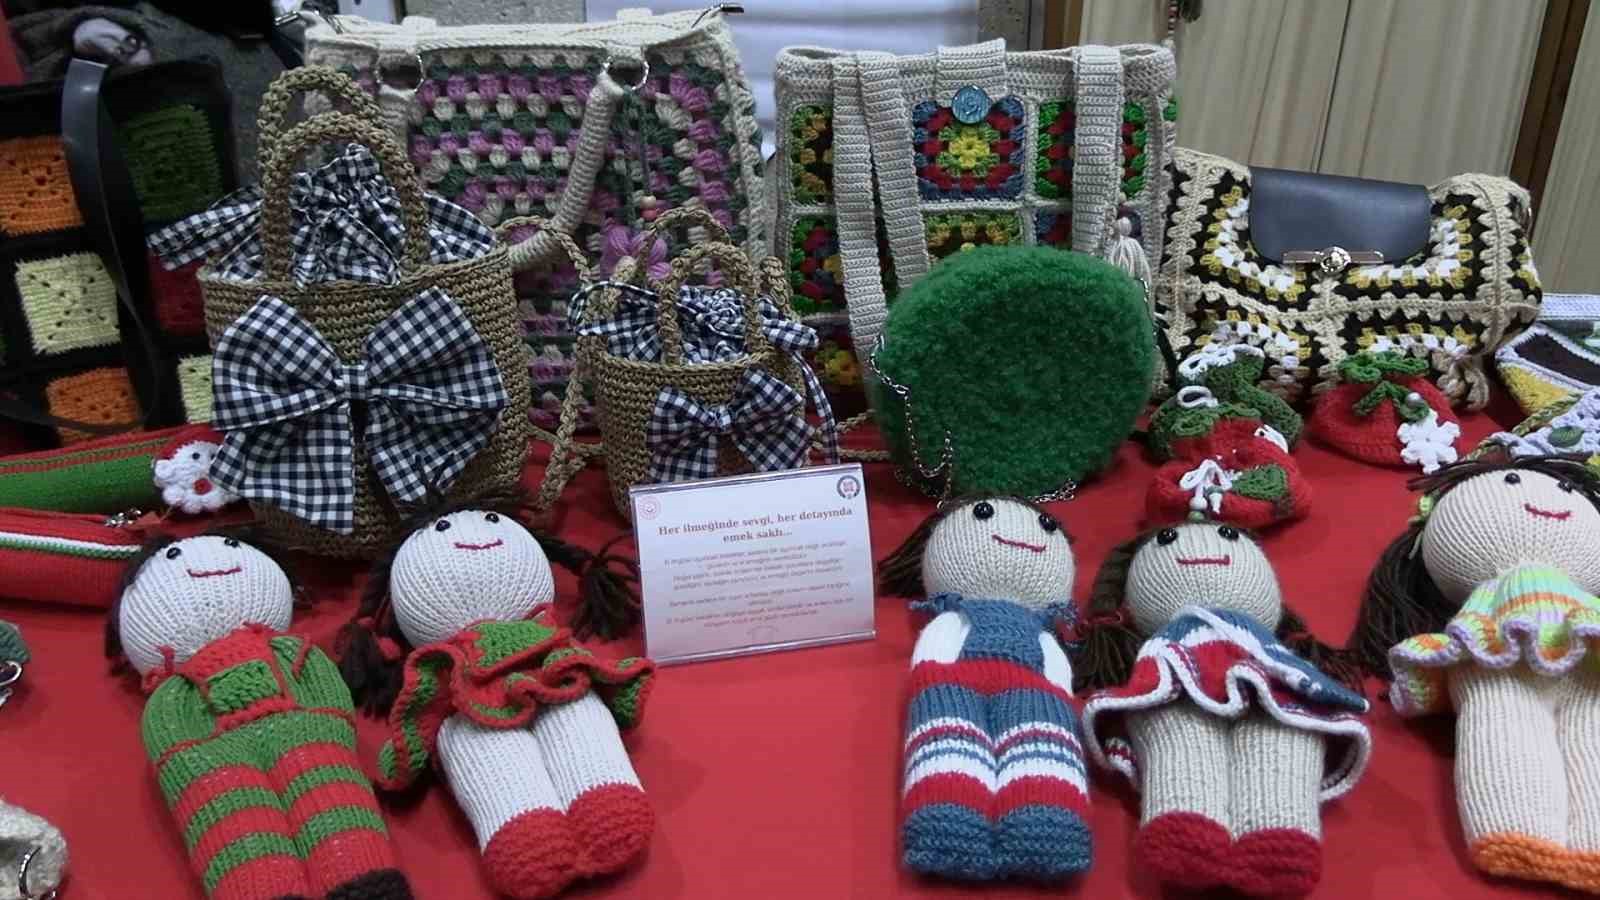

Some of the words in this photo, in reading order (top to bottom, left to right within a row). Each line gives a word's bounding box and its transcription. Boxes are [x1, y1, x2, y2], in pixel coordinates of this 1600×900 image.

[658, 526, 680, 536] Her
[777, 512, 797, 523] her
[800, 506, 853, 520] detayında
[722, 531, 753, 542] emek
